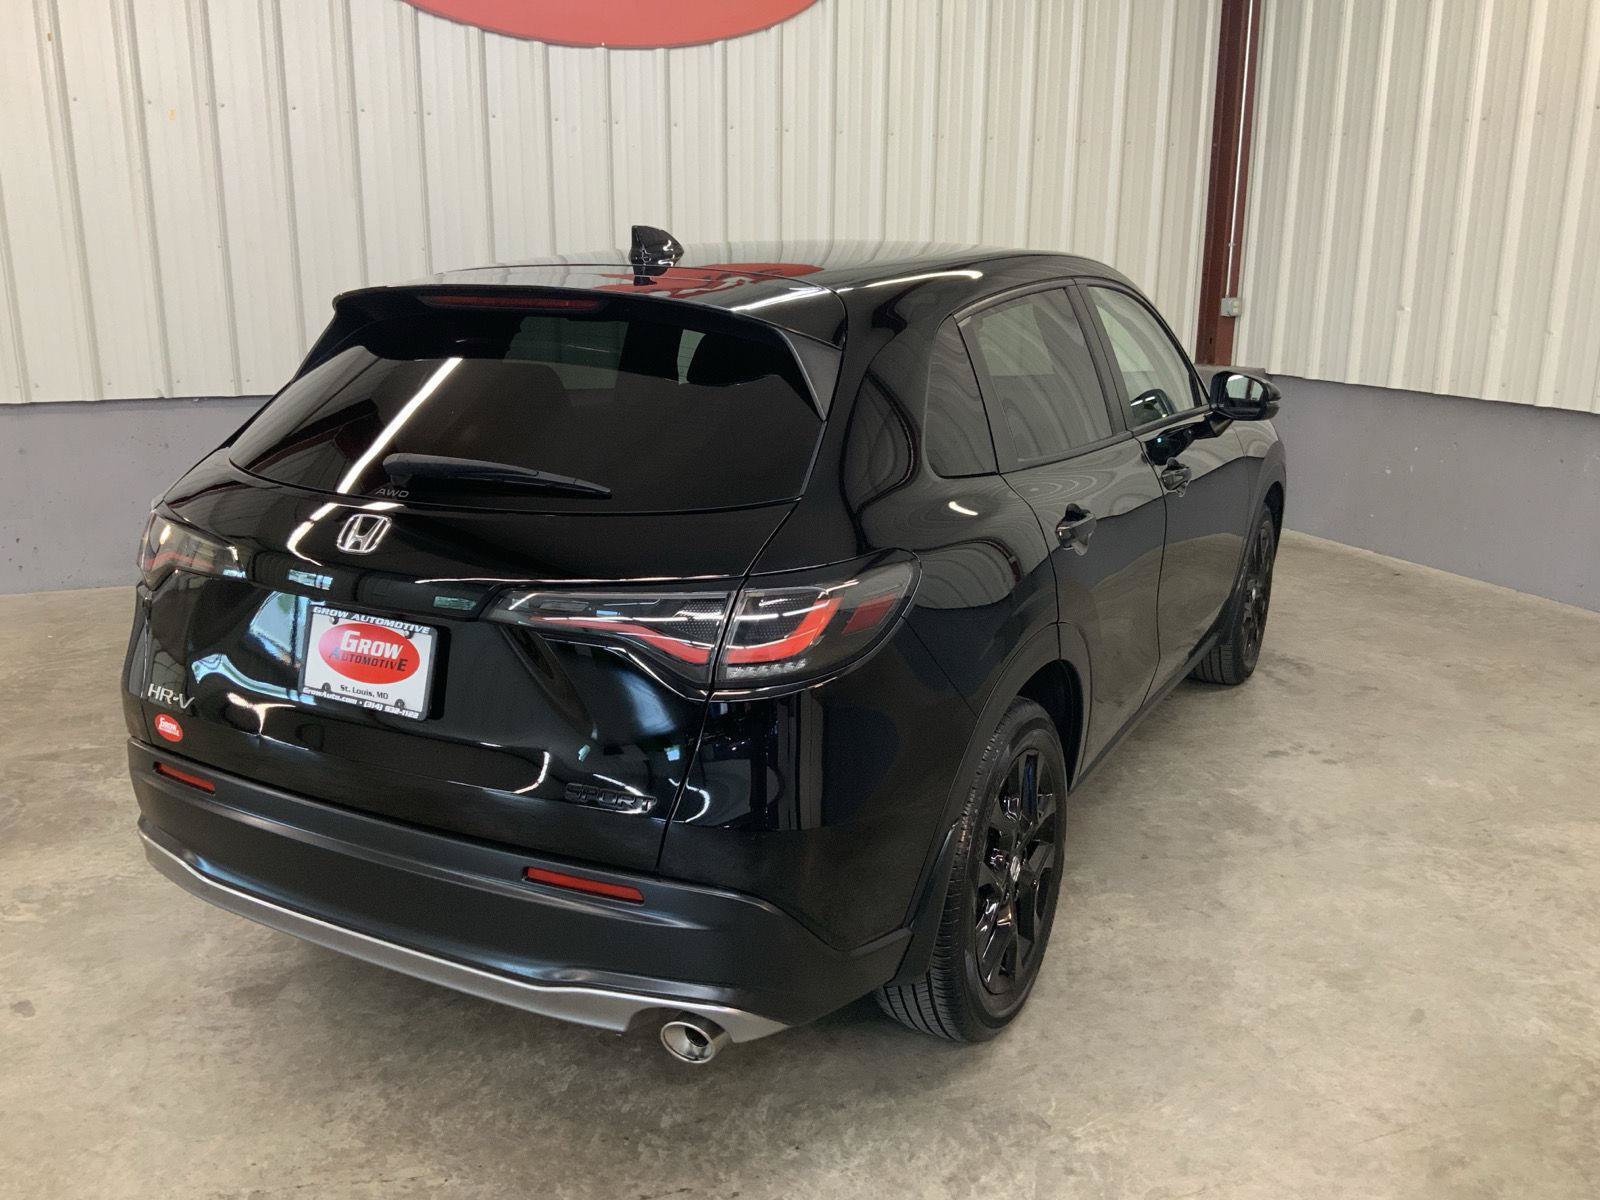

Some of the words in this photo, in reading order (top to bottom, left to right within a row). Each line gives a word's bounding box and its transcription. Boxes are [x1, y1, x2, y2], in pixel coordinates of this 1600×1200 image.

[375, 488, 409, 498] AWD
[313, 606, 349, 619] GROW
[351, 613, 431, 634] AUTOMOTIVE
[329, 646, 408, 671] AUTOMOTIVE
[147, 683, 195, 709] HR-V
[302, 687, 358, 705] GrowAuto.com
[340, 684, 351, 693] St.
[565, 783, 657, 813] SPORT
